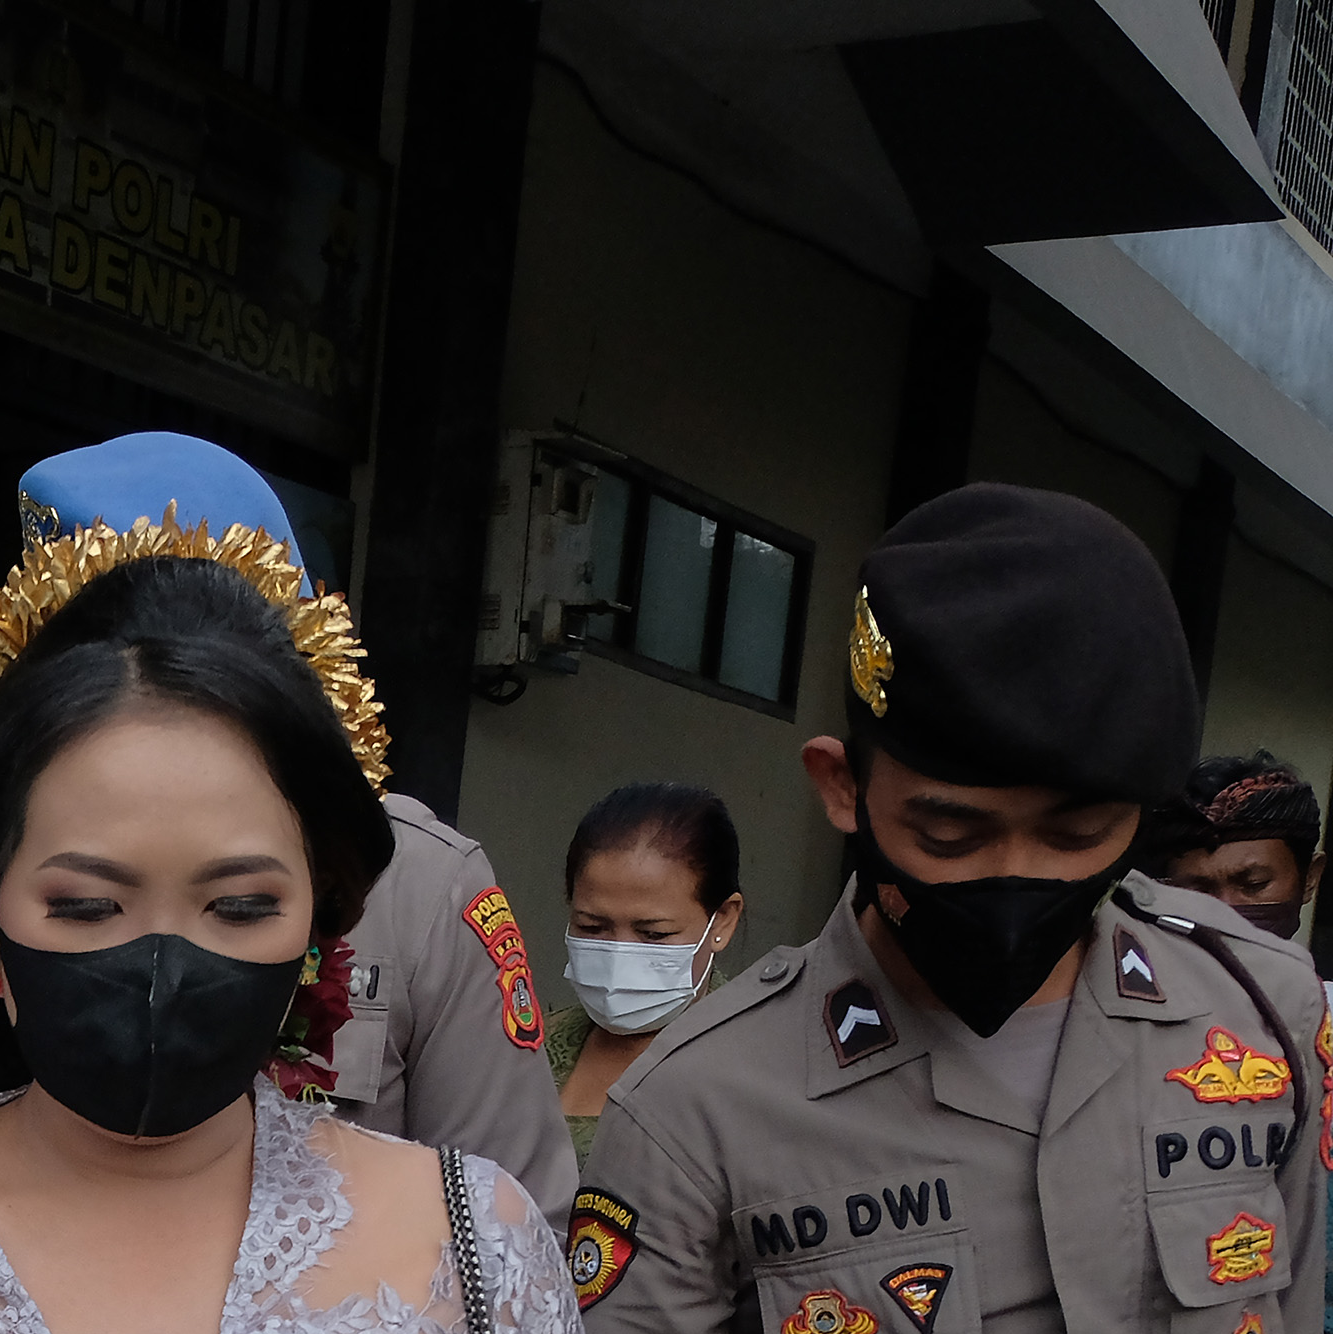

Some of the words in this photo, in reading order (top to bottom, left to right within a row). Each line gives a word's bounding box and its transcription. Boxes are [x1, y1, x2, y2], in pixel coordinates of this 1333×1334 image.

[72, 139, 242, 277] POLRI
[49, 212, 335, 395] DENPASAR
[1155, 1122, 1287, 1178] POLR
[751, 1205, 828, 1257] MD
[846, 1178, 952, 1238] DWI
